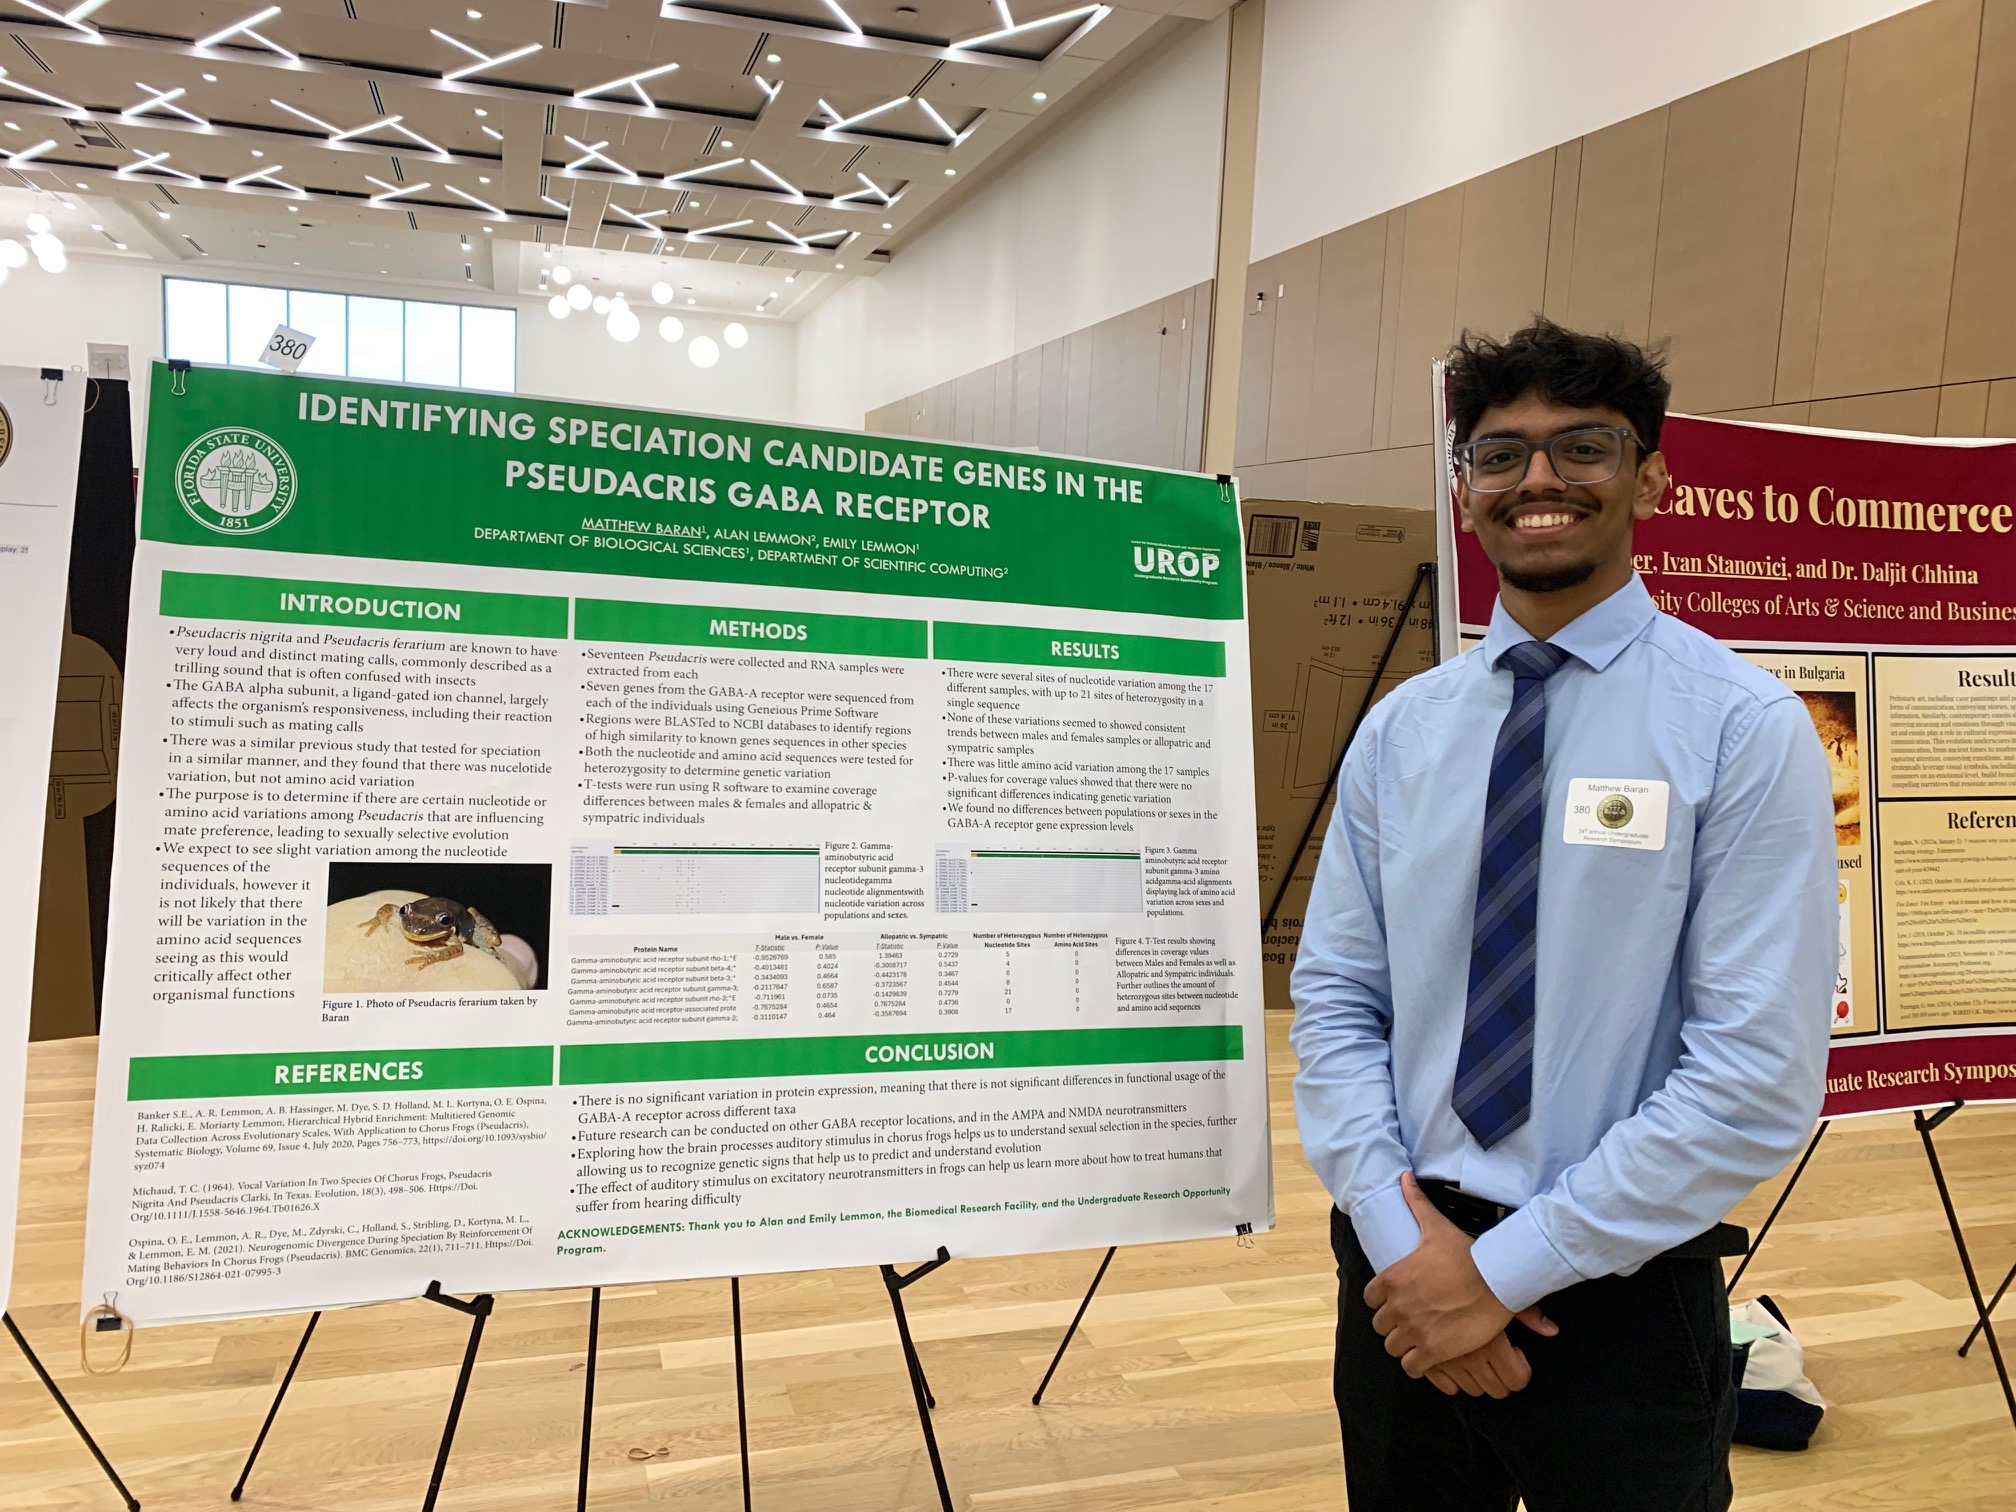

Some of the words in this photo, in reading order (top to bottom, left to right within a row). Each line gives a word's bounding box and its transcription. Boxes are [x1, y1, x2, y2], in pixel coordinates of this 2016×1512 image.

[269, 333, 307, 360] 380
[298, 392, 536, 441] IDENTIFYING
[548, 416, 751, 463] SPECIATION
[763, 439, 943, 482] CANDIDATE
[953, 459, 1046, 493] GENES
[1056, 470, 1084, 497] IN
[1093, 475, 1142, 504] THE
[184, 449, 207, 506] FLORIDA
[207, 434, 250, 450] STATE
[254, 438, 290, 514] UNIVERSITY
[505, 459, 716, 504] PSEUDACRIS
[727, 481, 824, 514] GABA
[836, 490, 990, 529] RECEPTOR
[1762, 484, 1799, 524] to
[1809, 486, 2014, 533] Commerce
[219, 516, 250, 529] 1851
[581, 516, 651, 531] MATTHEW
[713, 528, 749, 541] ALAN
[823, 536, 857, 549] EMILY
[474, 527, 565, 545] DEPARTMENT
[568, 534, 590, 546] OF
[594, 536, 679, 554] BIOLOGICAL
[682, 542, 754, 562] SCIENCES¹,
[757, 549, 838, 566] DEPARTMENT
[841, 555, 860, 567] OF
[863, 557, 926, 573] SCIENTIFIC
[929, 562, 1008, 579] COMPUTING²
[1134, 546, 1220, 579] UROP
[1269, 562, 1290, 570] Blanco
[1297, 564, 1314, 572] White
[1630, 554, 1658, 573] er,
[1662, 551, 1702, 574] Ivan
[1707, 553, 1792, 580] Stanovici,
[1796, 559, 1827, 579] and
[1832, 561, 1858, 580] Dr.
[1862, 562, 1908, 587] Daljit
[1912, 564, 1979, 584] Chhina
[280, 592, 462, 620] INTRODUCTION
[1334, 597, 1346, 608] 1.1
[1363, 598, 1380, 606] cm
[1652, 590, 1683, 615] sity
[1687, 592, 1760, 618] Colleges
[1765, 594, 1783, 615] of
[1785, 596, 1819, 616] Arts
[1824, 598, 1839, 617] &
[1844, 598, 1904, 619] Science
[1910, 601, 1942, 620] and
[1948, 601, 2016, 621] Busines
[1340, 614, 1351, 626] 12
[1369, 615, 1378, 626] in
[1381, 616, 1395, 628] 36
[1409, 617, 1418, 629] in
[710, 619, 808, 640] METHODS
[176, 625, 246, 640] Pseudacris
[249, 630, 292, 645] nigrita
[296, 633, 320, 644] and
[323, 633, 389, 648] Pseudacris
[392, 637, 445, 651] ferarium
[449, 644, 468, 652] are
[470, 641, 512, 654] known
[515, 646, 528, 655] to
[530, 644, 558, 657] have
[1052, 640, 1120, 660] RESULTS
[1784, 665, 1796, 679] in
[1800, 666, 1845, 682] Bulgaria
[1958, 669, 2016, 687] Result
[1588, 784, 1622, 792] Matthew
[1624, 785, 1648, 794] Baran
[1573, 806, 1590, 814] 380
[582, 812, 640, 826] sympatric
[642, 812, 705, 824] individuals
[947, 817, 991, 828] GABA-A
[994, 820, 1034, 832] receptor
[1035, 822, 1058, 832] gene
[1059, 821, 1108, 833] expression
[1109, 820, 1134, 832] levels
[1948, 810, 2016, 829] Referen
[1608, 830, 1649, 839] Undergraduate
[1609, 837, 1642, 845] Symposium
[824, 841, 850, 852] Figure
[851, 841, 858, 849] 2.
[859, 841, 894, 850] Gamma-
[1838, 854, 1862, 869] used
[1146, 908, 1185, 918] populations.
[1115, 936, 1136, 947] Figure
[1144, 936, 1166, 945] T-Test
[1167, 936, 1188, 945] results
[1189, 936, 1216, 947] showing
[1263, 953, 1285, 964] Boa
[322, 1000, 353, 1011] Figure
[356, 1000, 363, 1008] 1.
[366, 998, 394, 1008] Photo
[396, 998, 407, 1007] of
[408, 997, 456, 1007] Pseudacris
[458, 997, 498, 1007] ferarium
[500, 996, 524, 1006] taken
[526, 996, 538, 1007] by
[322, 1012, 350, 1023] Baran
[864, 1042, 994, 1063] CONCLUSION
[274, 1062, 424, 1084] REFERENCES
[1826, 1074, 1862, 1094] uate
[1866, 1062, 1940, 1089] Research
[1944, 1062, 2016, 1084] Sympos
[578, 1111, 631, 1124] GABA-A
[635, 1110, 683, 1124] receptor
[685, 1109, 720, 1119] across
[723, 1104, 770, 1117] different
[773, 1105, 796, 1115] taxa
[134, 1161, 166, 1172] syz074
[575, 1199, 609, 1213] suffer
[612, 1198, 640, 1210] from
[644, 1196, 688, 1210] hearing
[690, 1191, 742, 1207] difficulty
[556, 1244, 607, 1257] Program.
